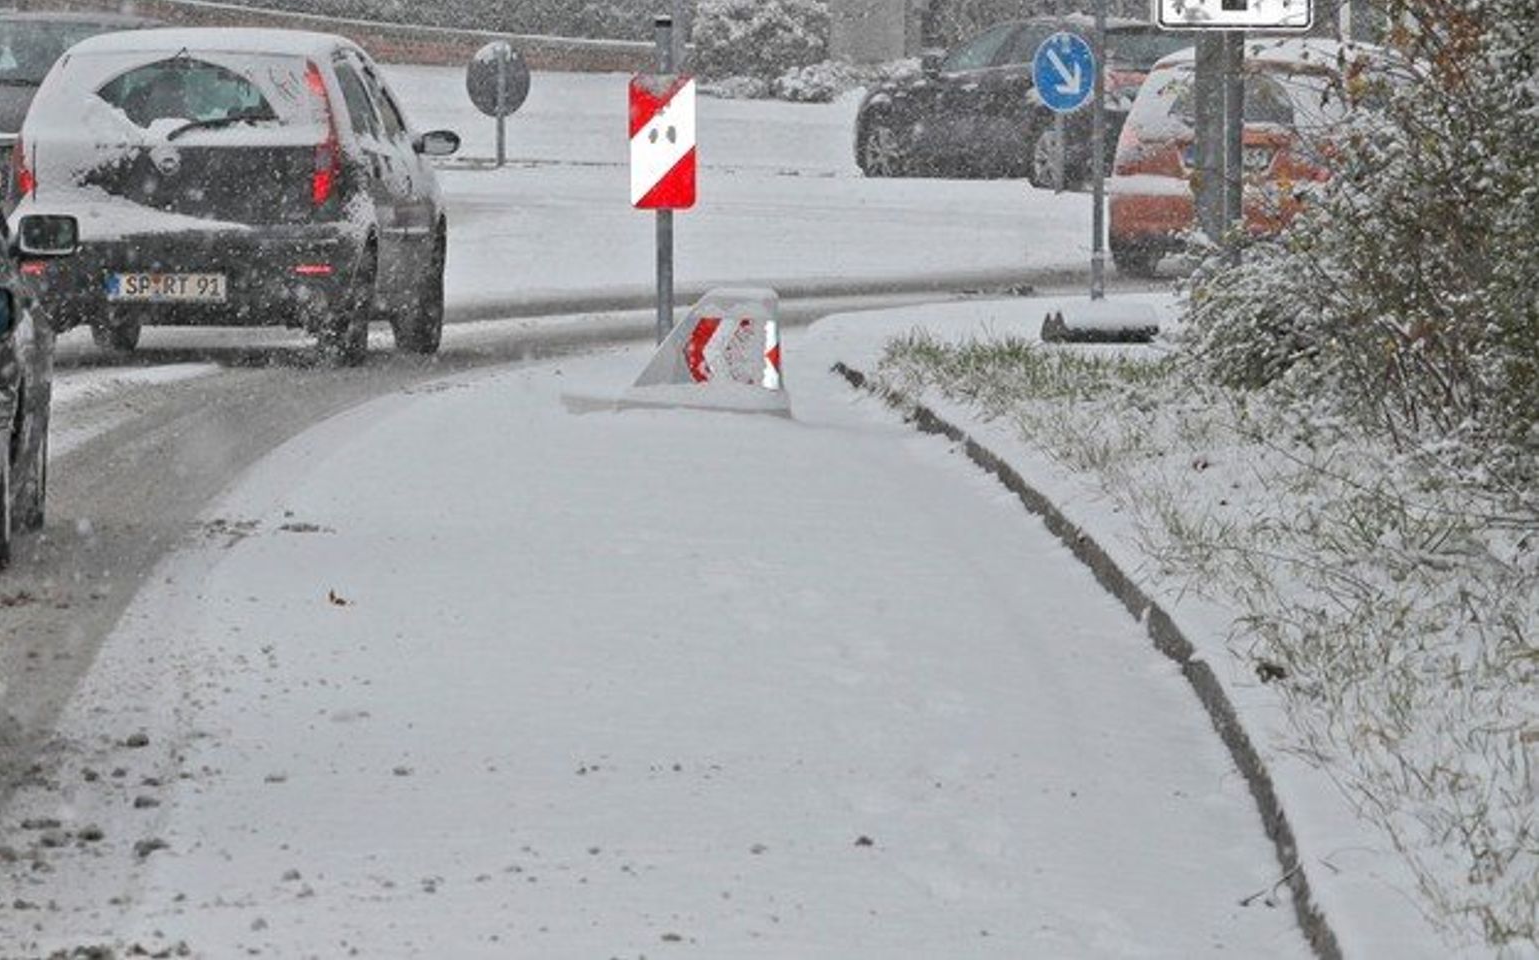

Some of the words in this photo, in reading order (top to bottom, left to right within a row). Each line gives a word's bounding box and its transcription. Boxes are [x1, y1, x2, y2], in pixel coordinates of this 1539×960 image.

[125, 275, 150, 294] SP
[163, 275, 188, 294] RT
[197, 275, 221, 296] 91
